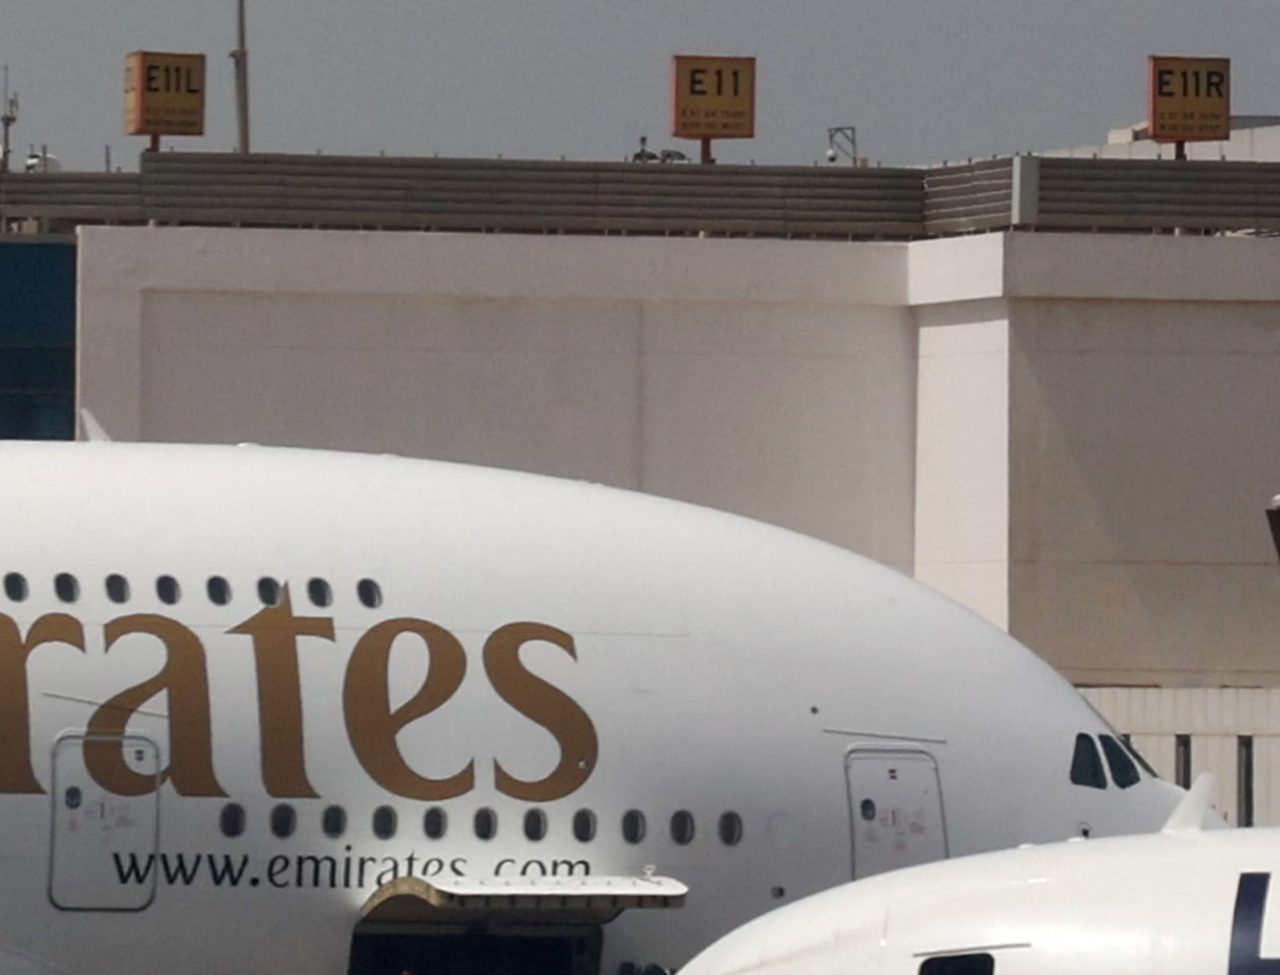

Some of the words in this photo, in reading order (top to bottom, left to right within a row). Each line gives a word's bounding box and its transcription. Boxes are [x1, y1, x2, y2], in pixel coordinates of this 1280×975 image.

[146, 65, 199, 93] E11L
[690, 68, 739, 96] E11
[1158, 69, 1224, 98] E11R
[114, 844, 591, 889] www.emiratescom
